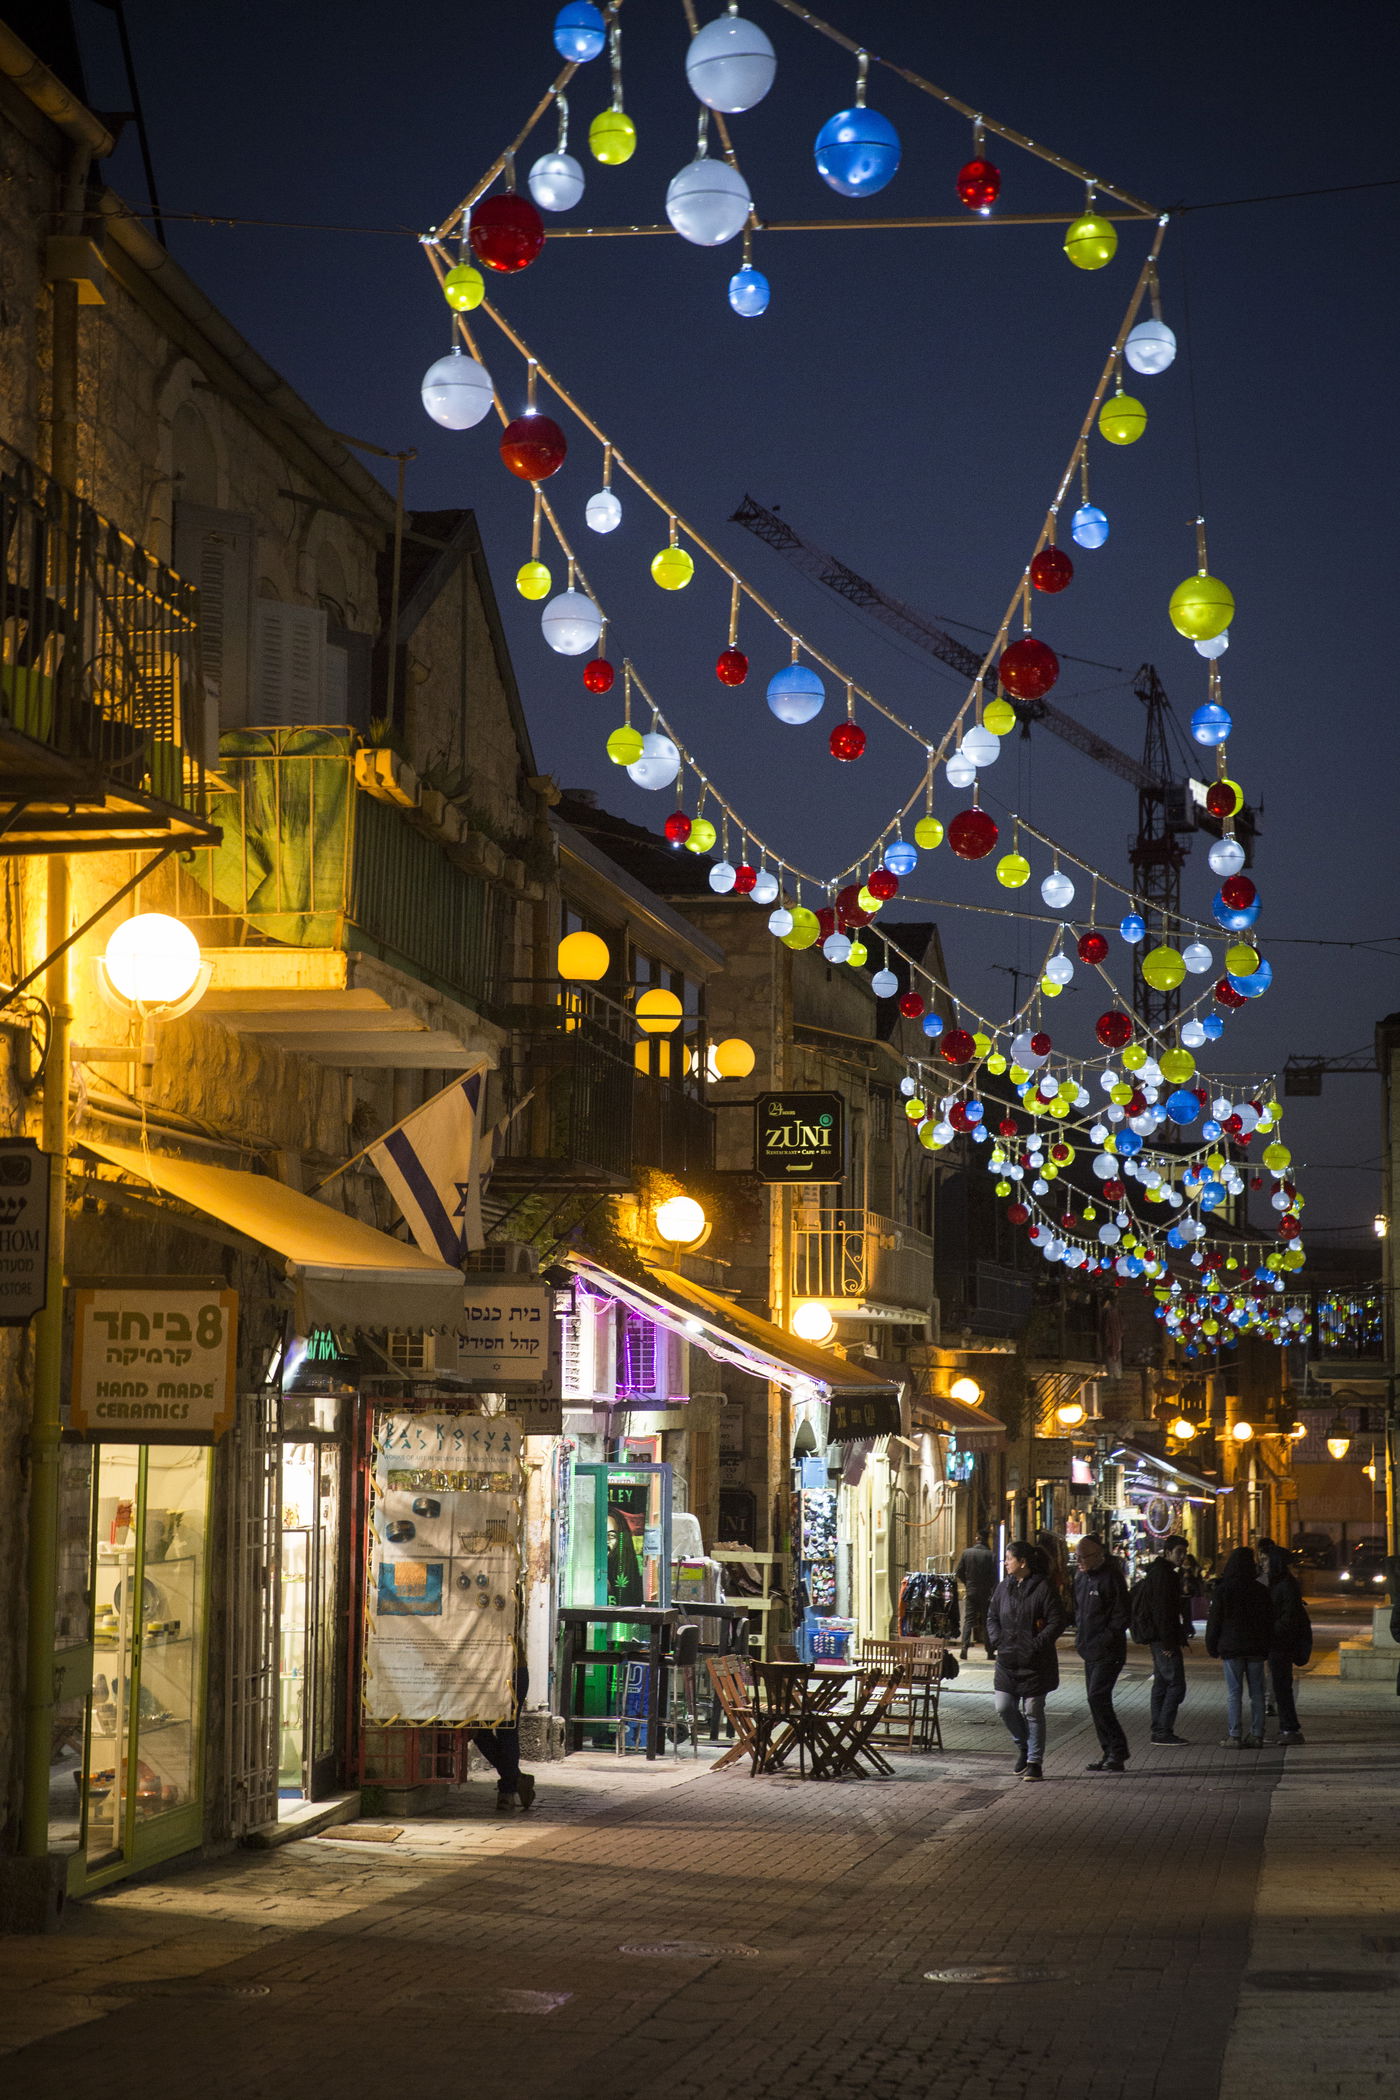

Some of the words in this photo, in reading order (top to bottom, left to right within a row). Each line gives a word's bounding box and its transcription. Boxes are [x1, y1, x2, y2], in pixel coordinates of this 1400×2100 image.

[508, 1306, 541, 1322] בית
[93, 1311, 192, 1341] ביחד
[196, 1304, 223, 1349] 8
[509, 1331, 540, 1354] קהל
[106, 1348, 193, 1366] קרמיקה
[96, 1381, 149, 1398] HAND
[157, 1382, 214, 1399] MADE
[96, 1403, 190, 1420] CERAMICS
[608, 1489, 633, 1503] LEY
[722, 1515, 746, 1531] NI
